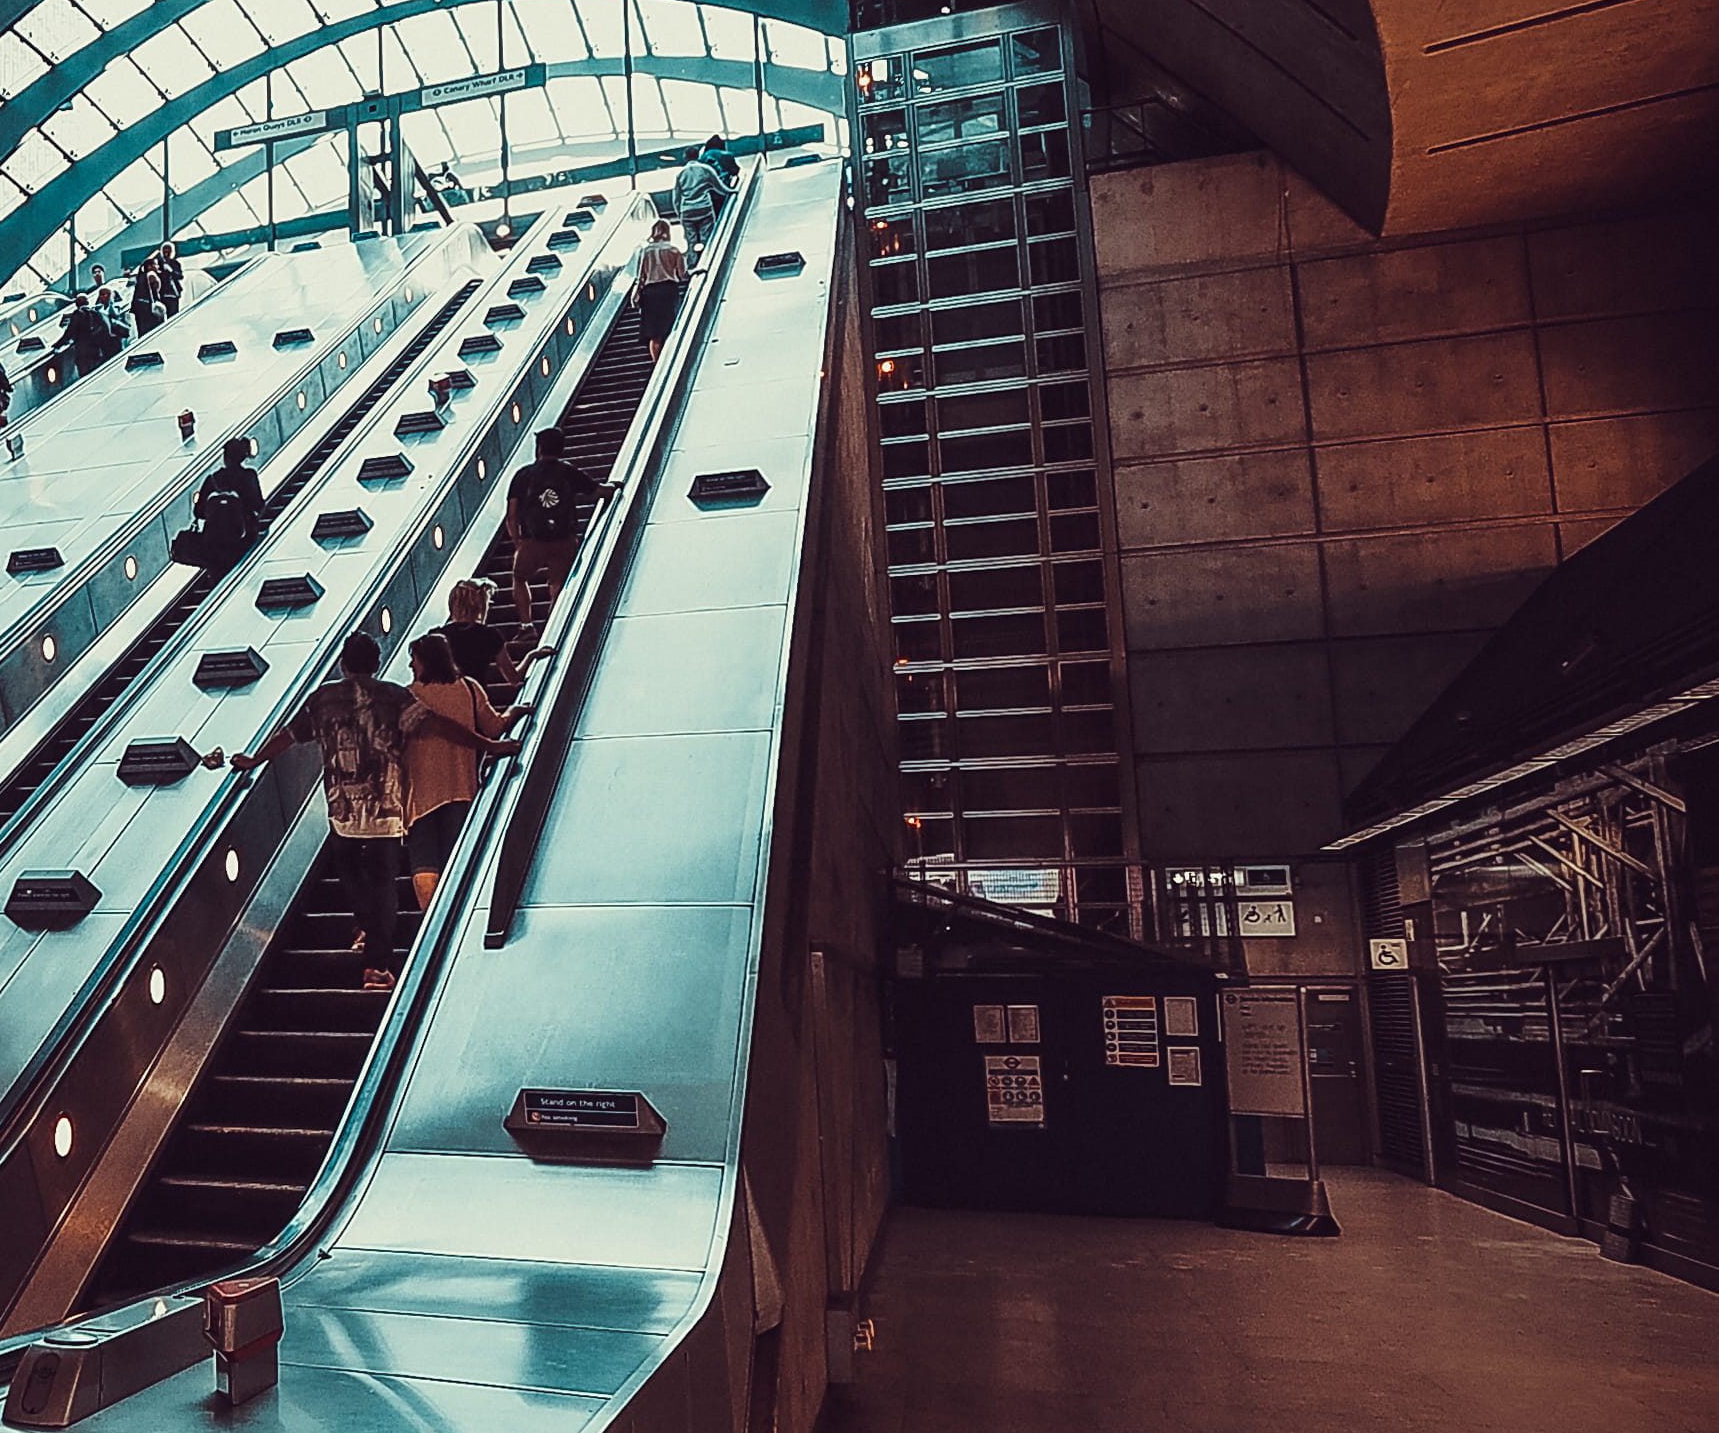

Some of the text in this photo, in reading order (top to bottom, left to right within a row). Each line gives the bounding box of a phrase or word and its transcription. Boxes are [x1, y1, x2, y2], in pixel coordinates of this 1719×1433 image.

[443, 73, 515, 95] Canary Wharf DLR
[540, 1097, 616, 1109] Stand on the right
